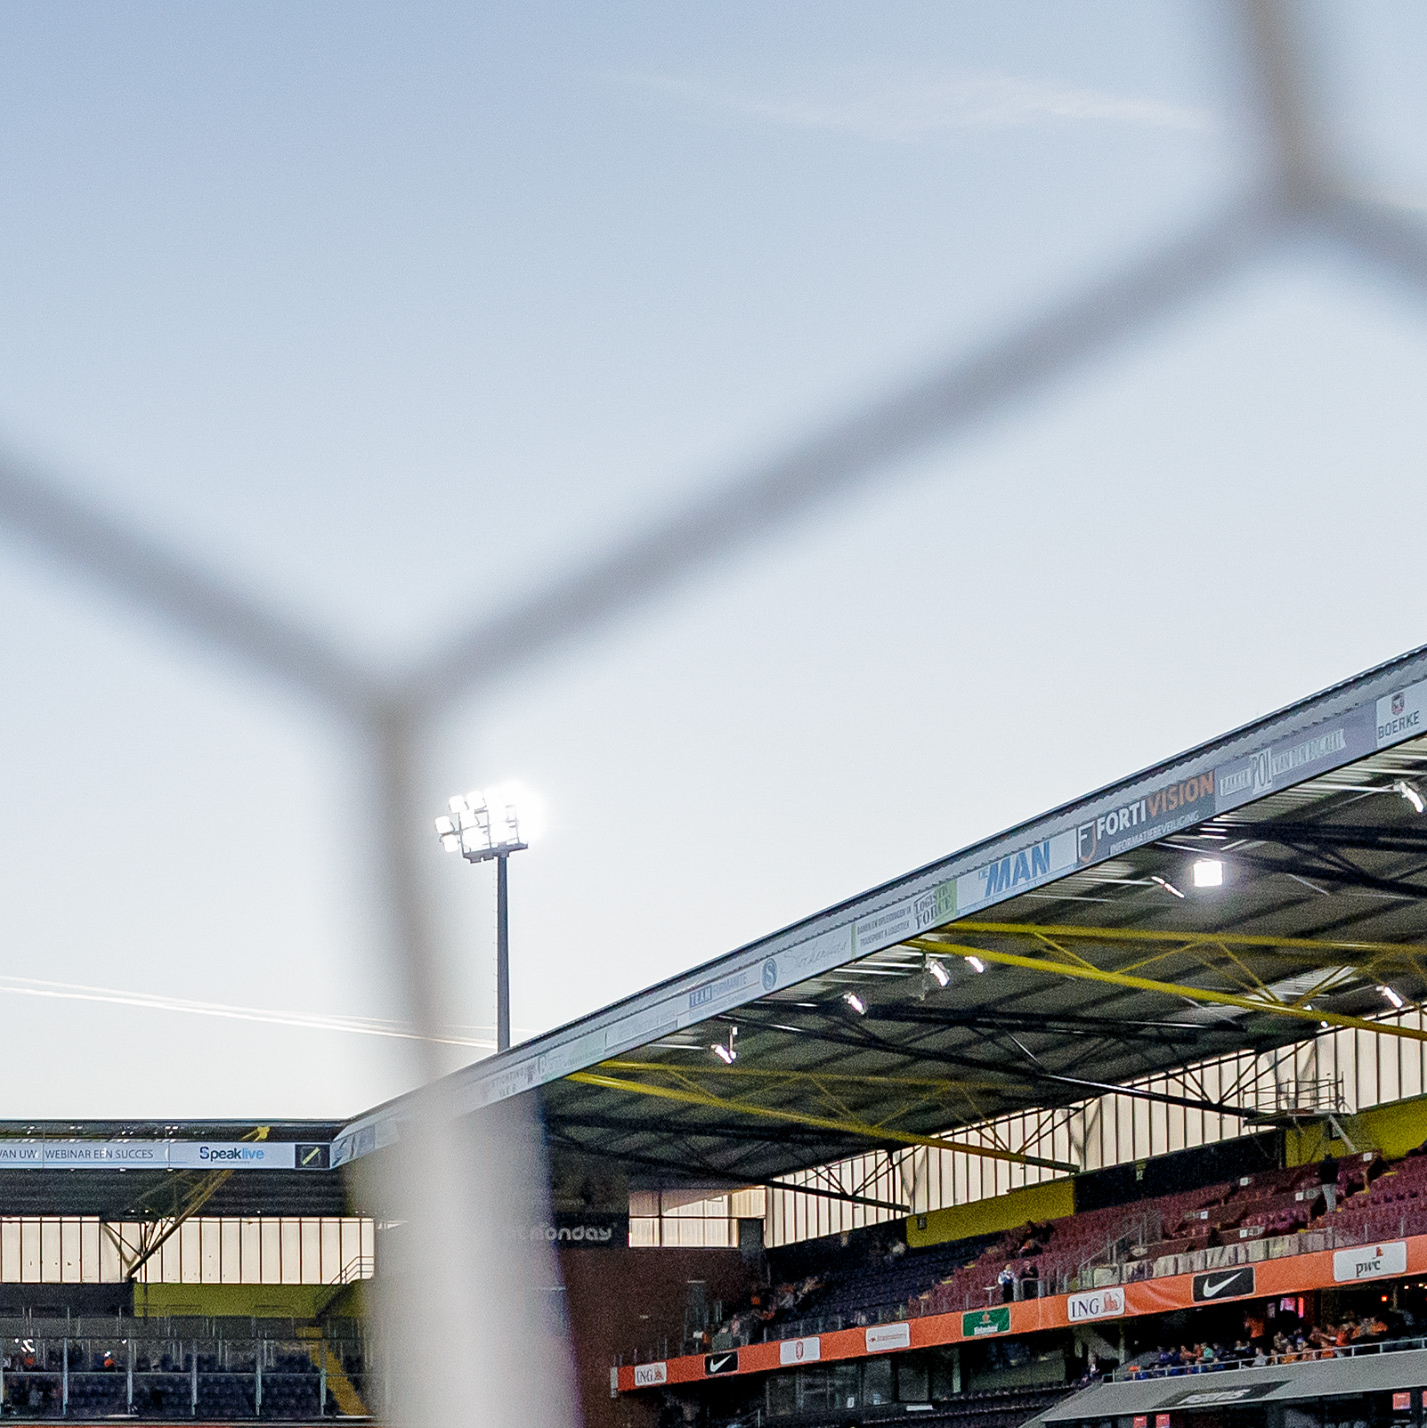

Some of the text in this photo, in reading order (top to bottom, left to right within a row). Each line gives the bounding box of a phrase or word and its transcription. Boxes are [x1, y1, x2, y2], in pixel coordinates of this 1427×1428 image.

[1377, 711, 1420, 739] BOERKE
[985, 842, 1051, 898] MAN
[19, 1150, 37, 1159] UW
[45, 1150, 91, 1159] WEBINAR
[115, 1150, 154, 1159] SUCCES
[1355, 1258, 1381, 1277] pwc
[1071, 1298, 1100, 1318] ING
